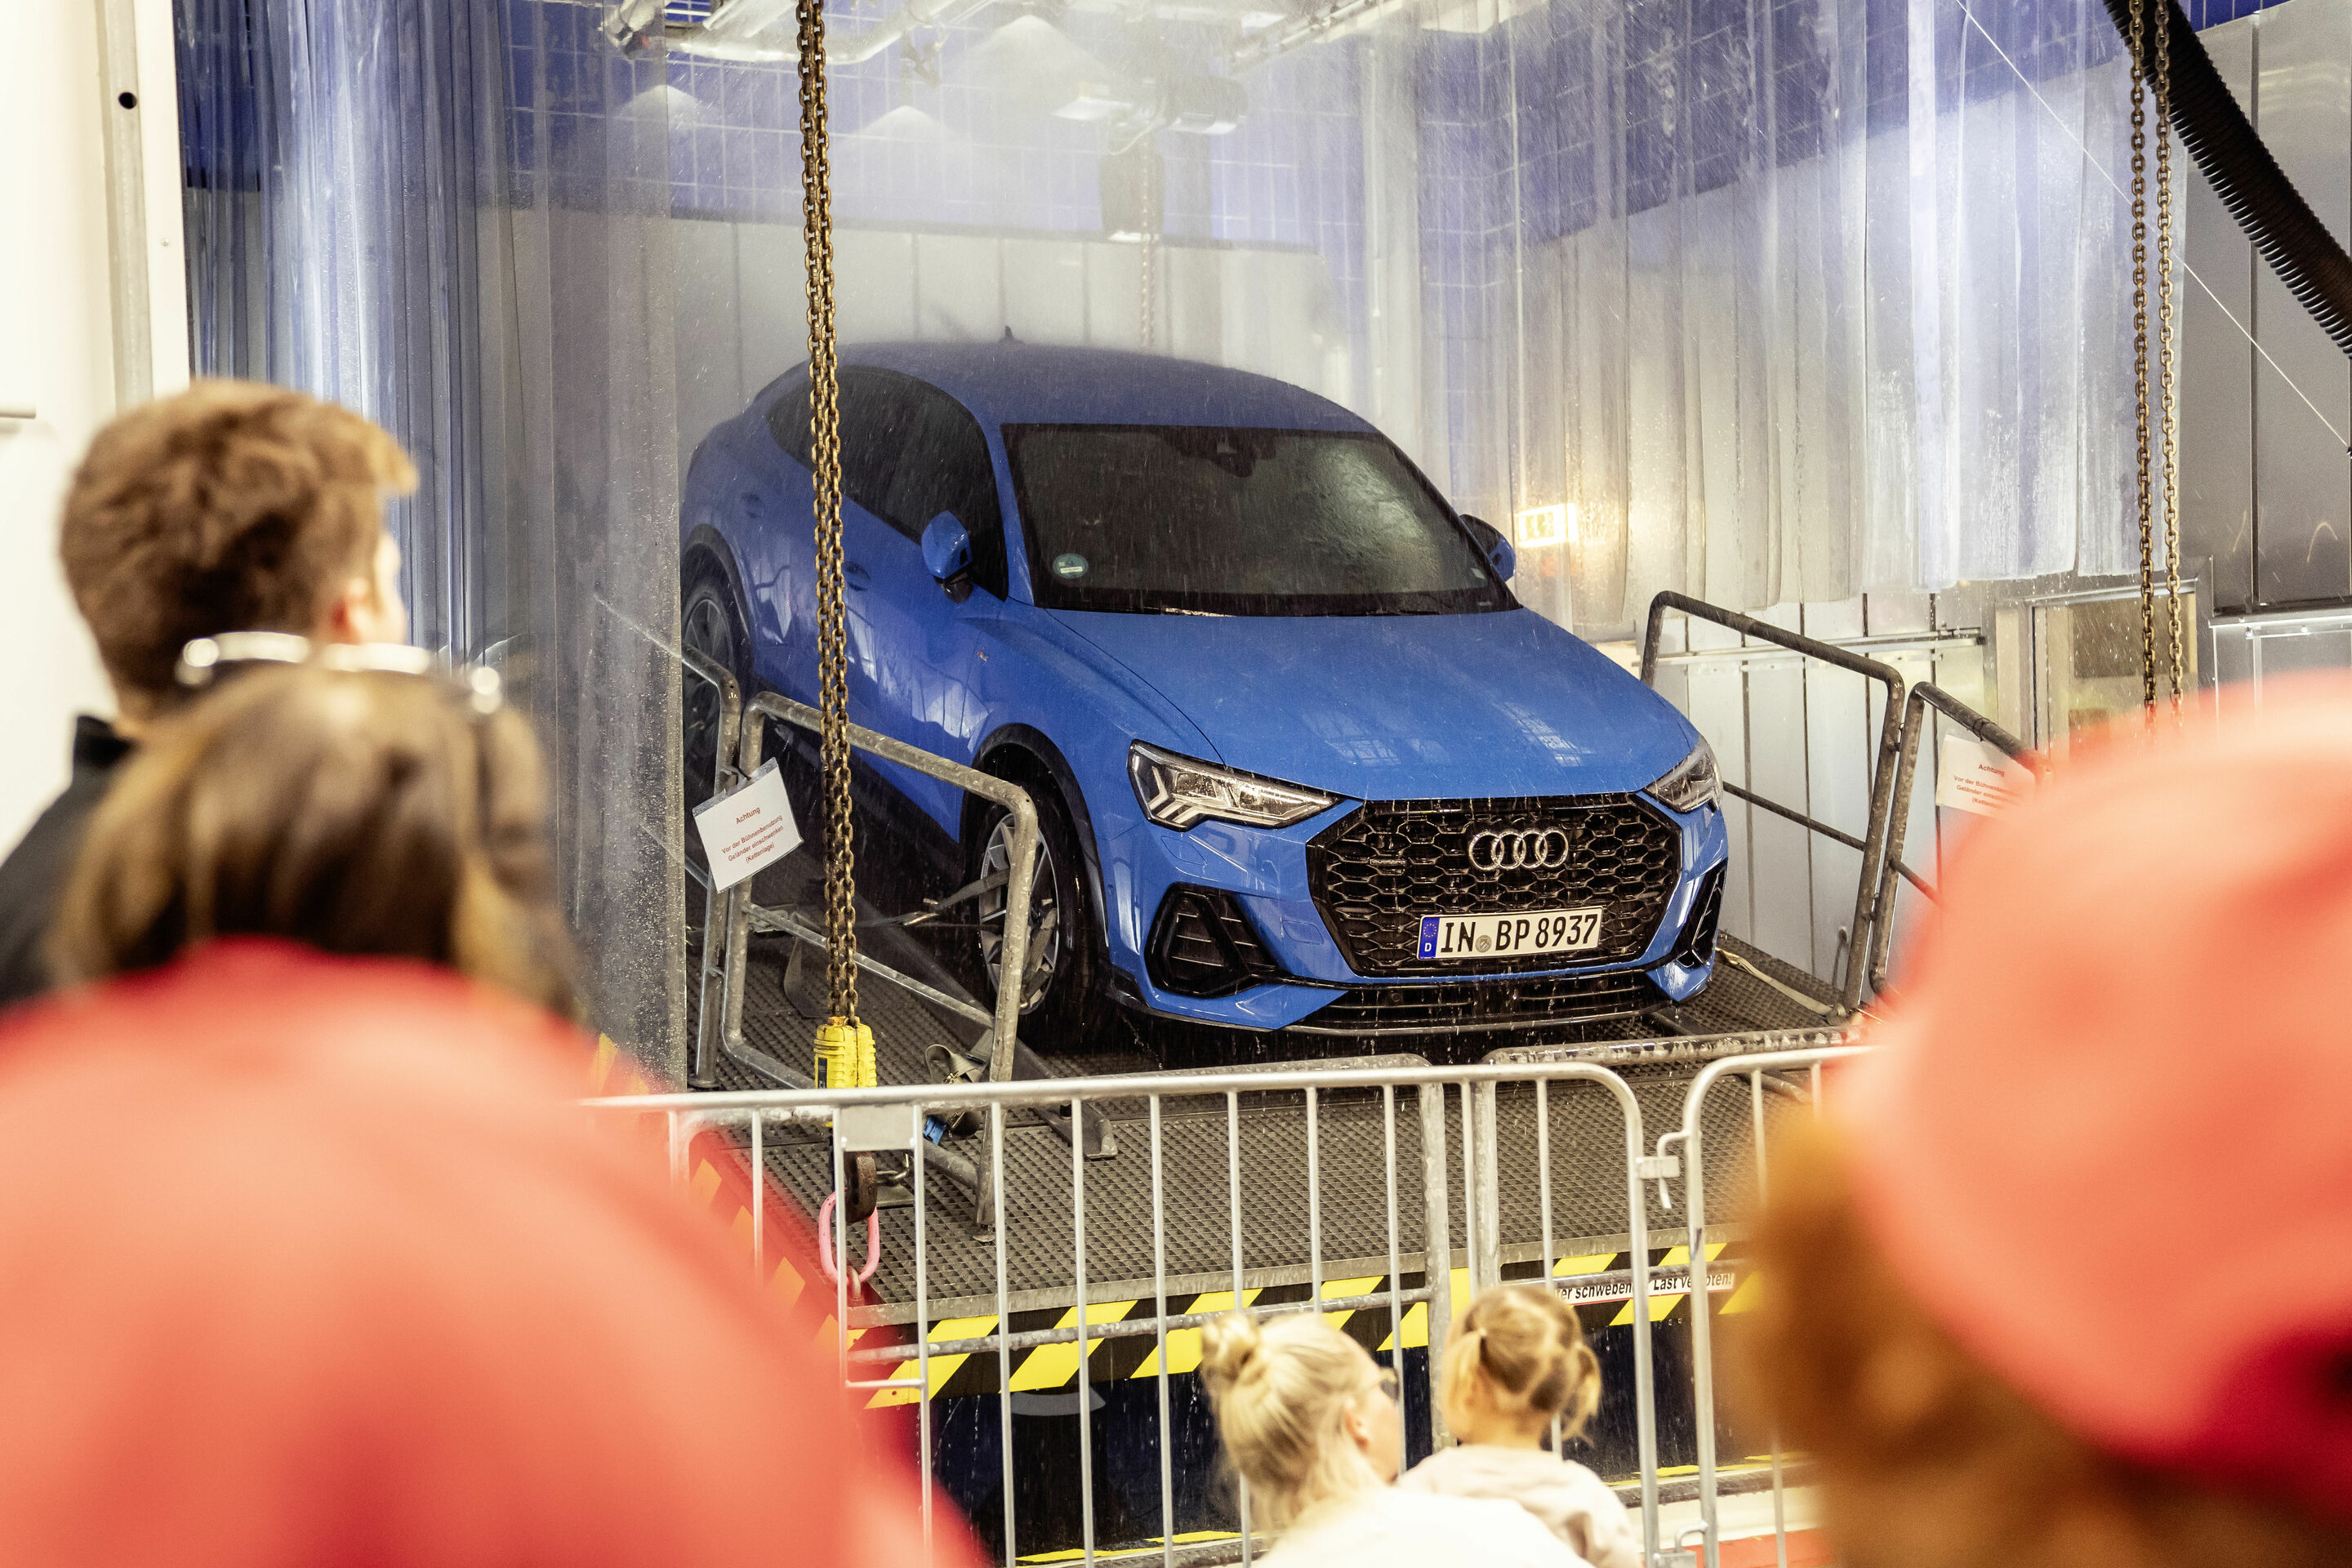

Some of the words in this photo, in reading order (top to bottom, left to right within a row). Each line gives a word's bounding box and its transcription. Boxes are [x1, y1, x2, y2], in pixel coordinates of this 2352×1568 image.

[1978, 764, 2005, 777] Achtung
[736, 807, 761, 824] Achtung
[732, 840, 741, 849] der
[741, 815, 783, 844] Bühnenbenutzung
[728, 845, 751, 862] Geländer
[751, 826, 784, 849] einschwenken
[746, 842, 775, 863] (Kettenlage)
[1441, 921, 1477, 953] IN
[1495, 919, 1530, 951] BP
[1535, 914, 1598, 948] 8937
[1424, 942, 1432, 952] D
[1575, 1282, 1635, 1299] schweben
[1653, 1277, 1677, 1290] Last
[1681, 1273, 1732, 1289] veoten!
